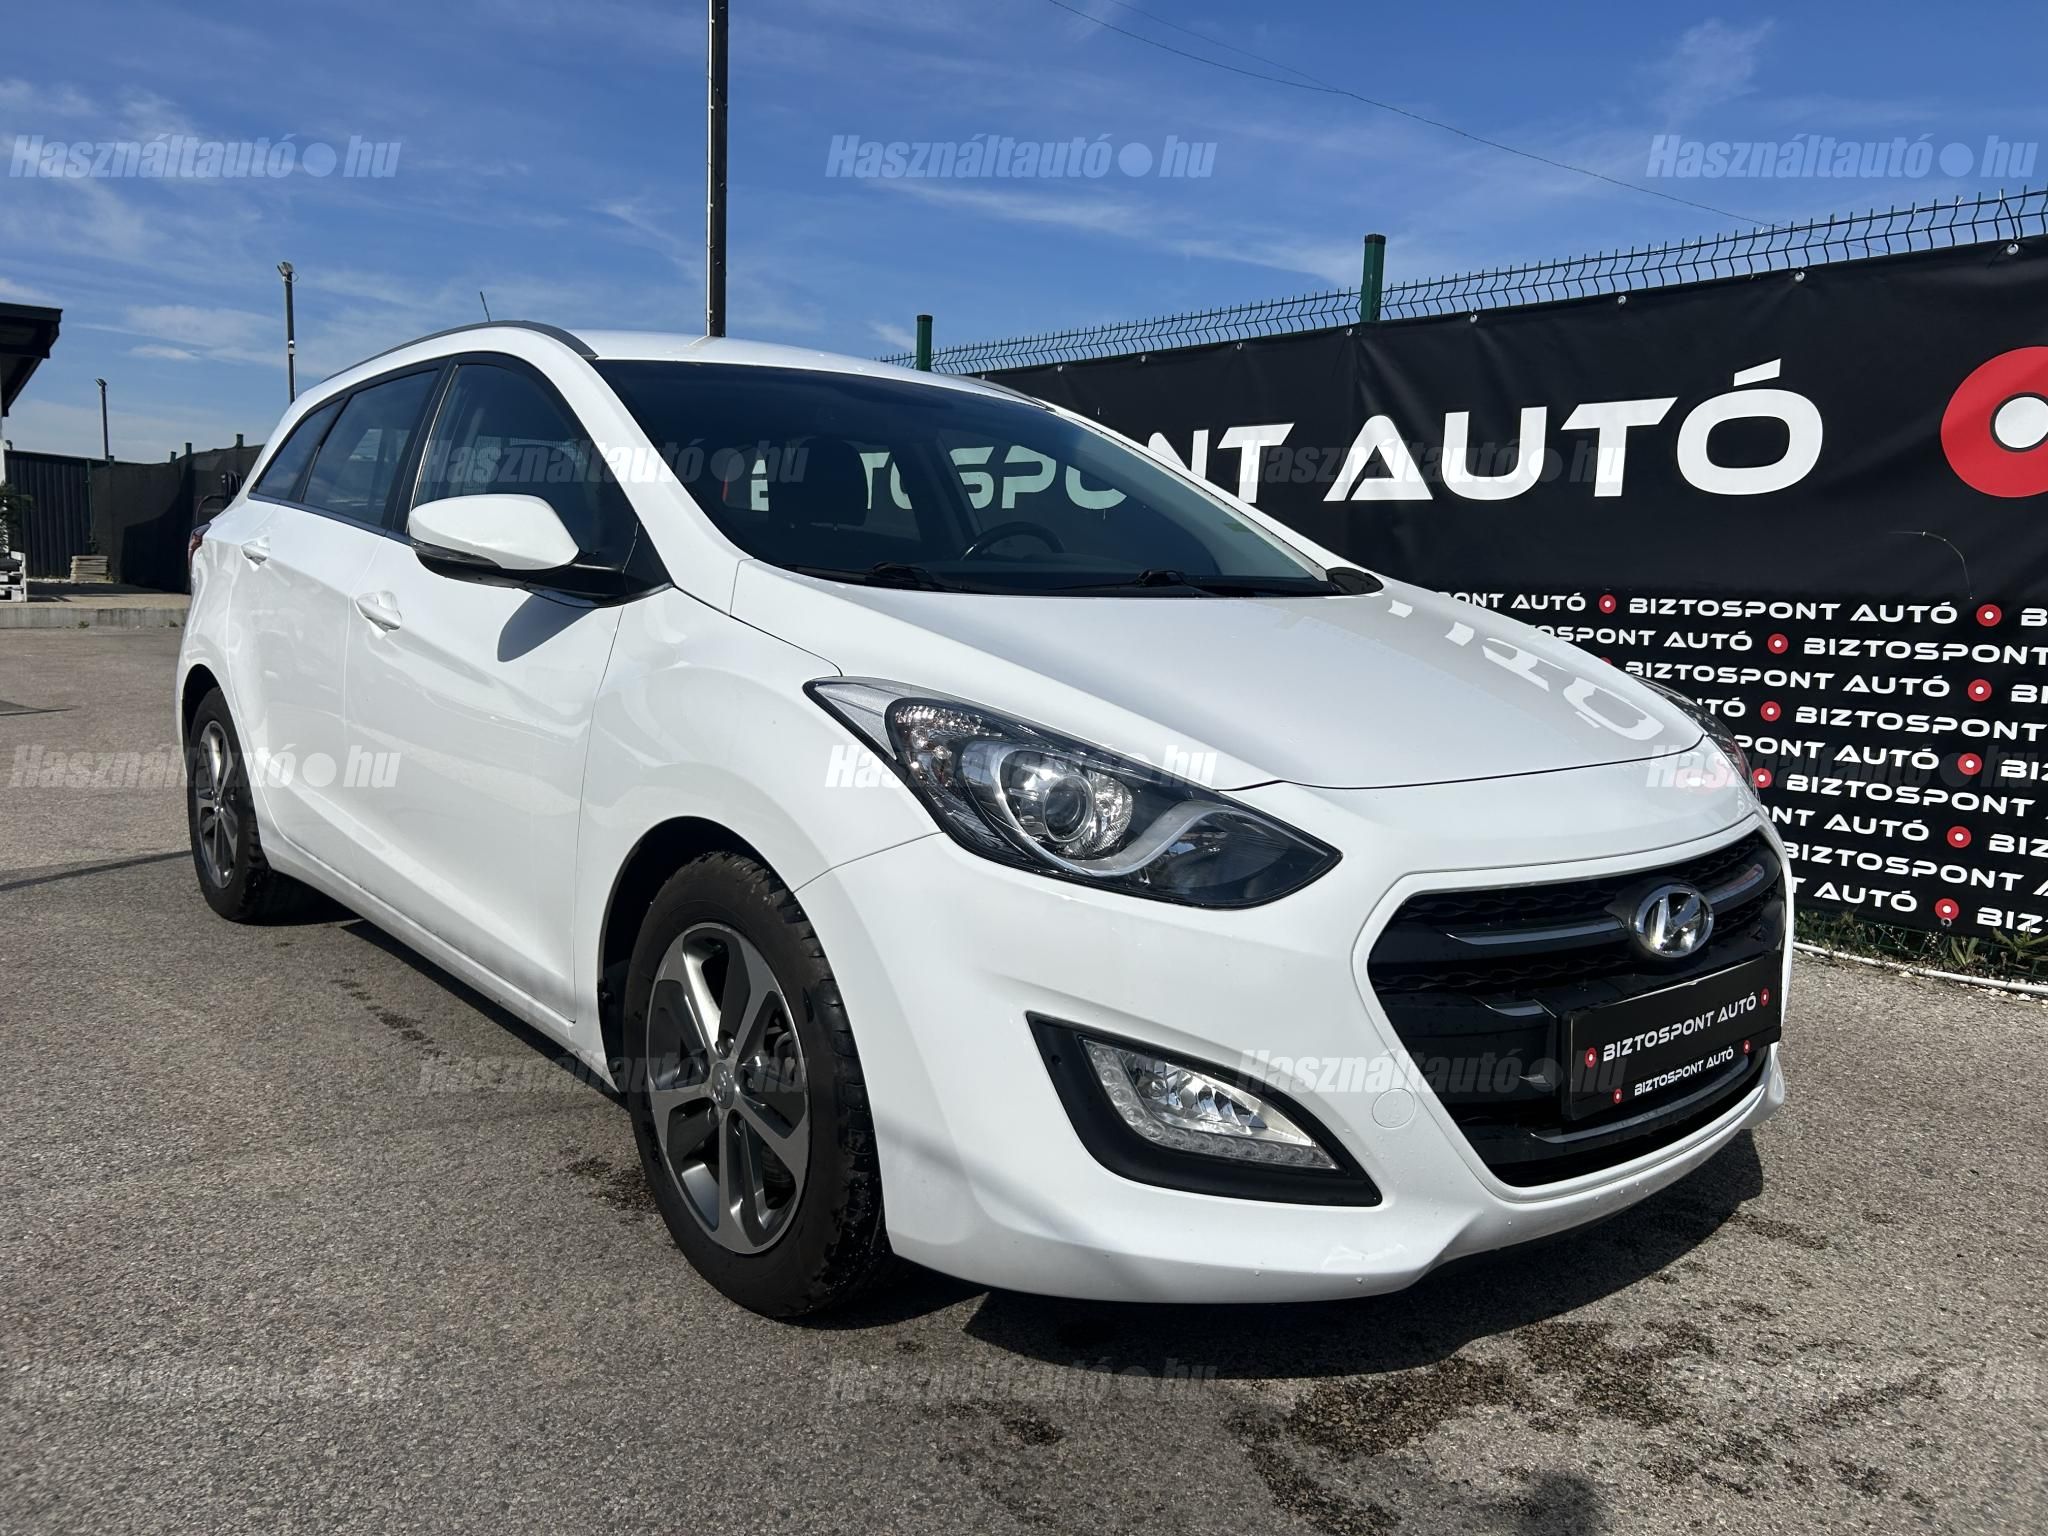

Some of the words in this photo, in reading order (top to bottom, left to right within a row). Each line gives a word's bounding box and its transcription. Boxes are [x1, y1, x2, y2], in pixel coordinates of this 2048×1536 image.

[1323, 358, 1823, 501] AUTÓ
[1511, 592, 1586, 611] AUTÓ
[1629, 598, 1841, 620] BIZTOSPONT
[1850, 601, 1958, 624] AUTÓ
[1663, 631, 1752, 651] AUTÓ
[1803, 638, 2048, 665] BIZTOSPONT
[1625, 661, 1835, 690] BIZTOSPONT
[1843, 675, 1950, 698] AUTÓ
[1795, 706, 2048, 742] BIZTOSPONT
[1833, 744, 1939, 770] AUTÓ
[1786, 774, 2035, 817] BIZTOSPONT
[1824, 814, 1929, 841] AUTÓ
[1784, 841, 2024, 891] BIZTOSPONT
[1814, 882, 1917, 912] AUTÓ
[1603, 1010, 1715, 1062] BIZTOSPONT
[1717, 992, 1756, 1024] AUTÓ
[1635, 1060, 1703, 1097] BIZTOSPONT
[1706, 1046, 1733, 1068] AUTÓ
